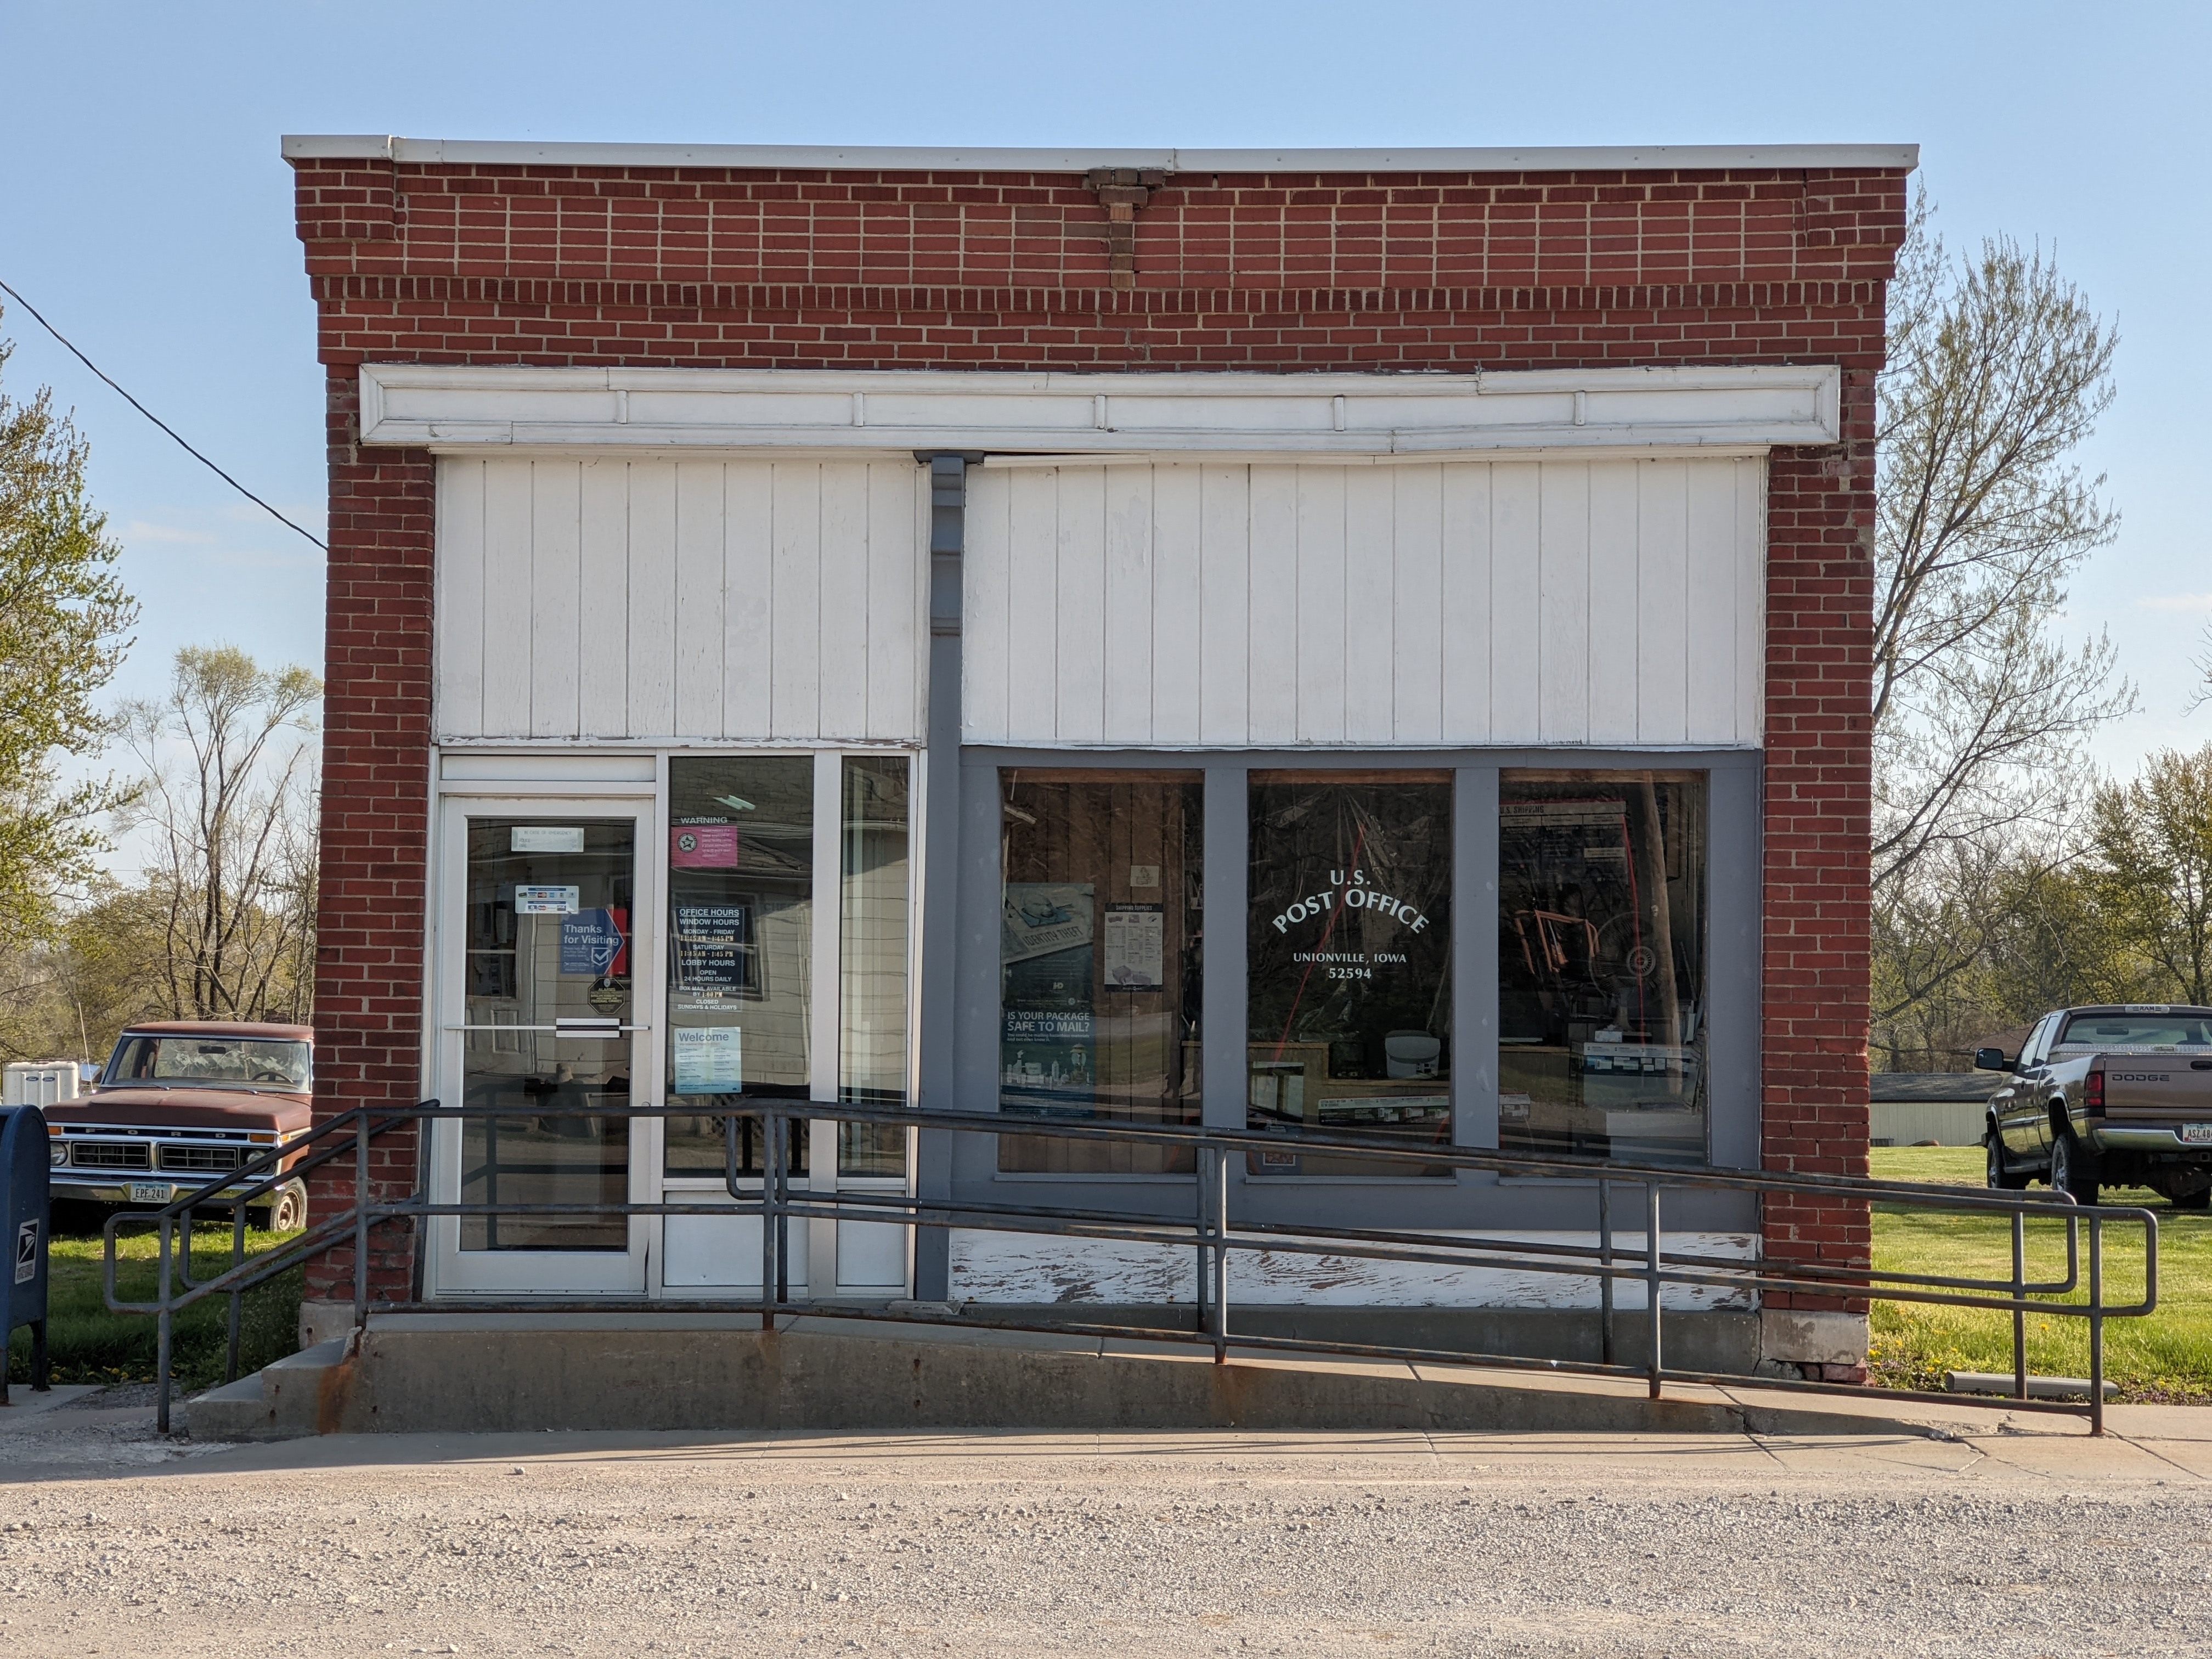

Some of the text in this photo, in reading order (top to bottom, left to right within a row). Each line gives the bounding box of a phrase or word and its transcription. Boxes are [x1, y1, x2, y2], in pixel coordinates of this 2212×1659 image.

[1514, 805, 1544, 814] SHIPPING
[1330, 870, 1371, 885] U.S.
[1272, 888, 1430, 934] POST OFFICE
[564, 924, 602, 933] Thanks
[564, 935, 619, 946] for Visiting
[1022, 926, 1084, 946] IDENTITY THEFT
[1293, 952, 1407, 964] UNIONVILLE, IOWA
[1328, 968, 1372, 979] 52594
[1007, 1012, 1090, 1020] IS YOUR PACKAGE
[1007, 1021, 1090, 1032] SAFE TO MAIL?
[678, 1032, 729, 1042] Welcome
[85, 1128, 226, 1138] FORD
[2188, 1129, 2212, 1138] ASZ 48
[136, 1188, 164, 1198] EPF 241
